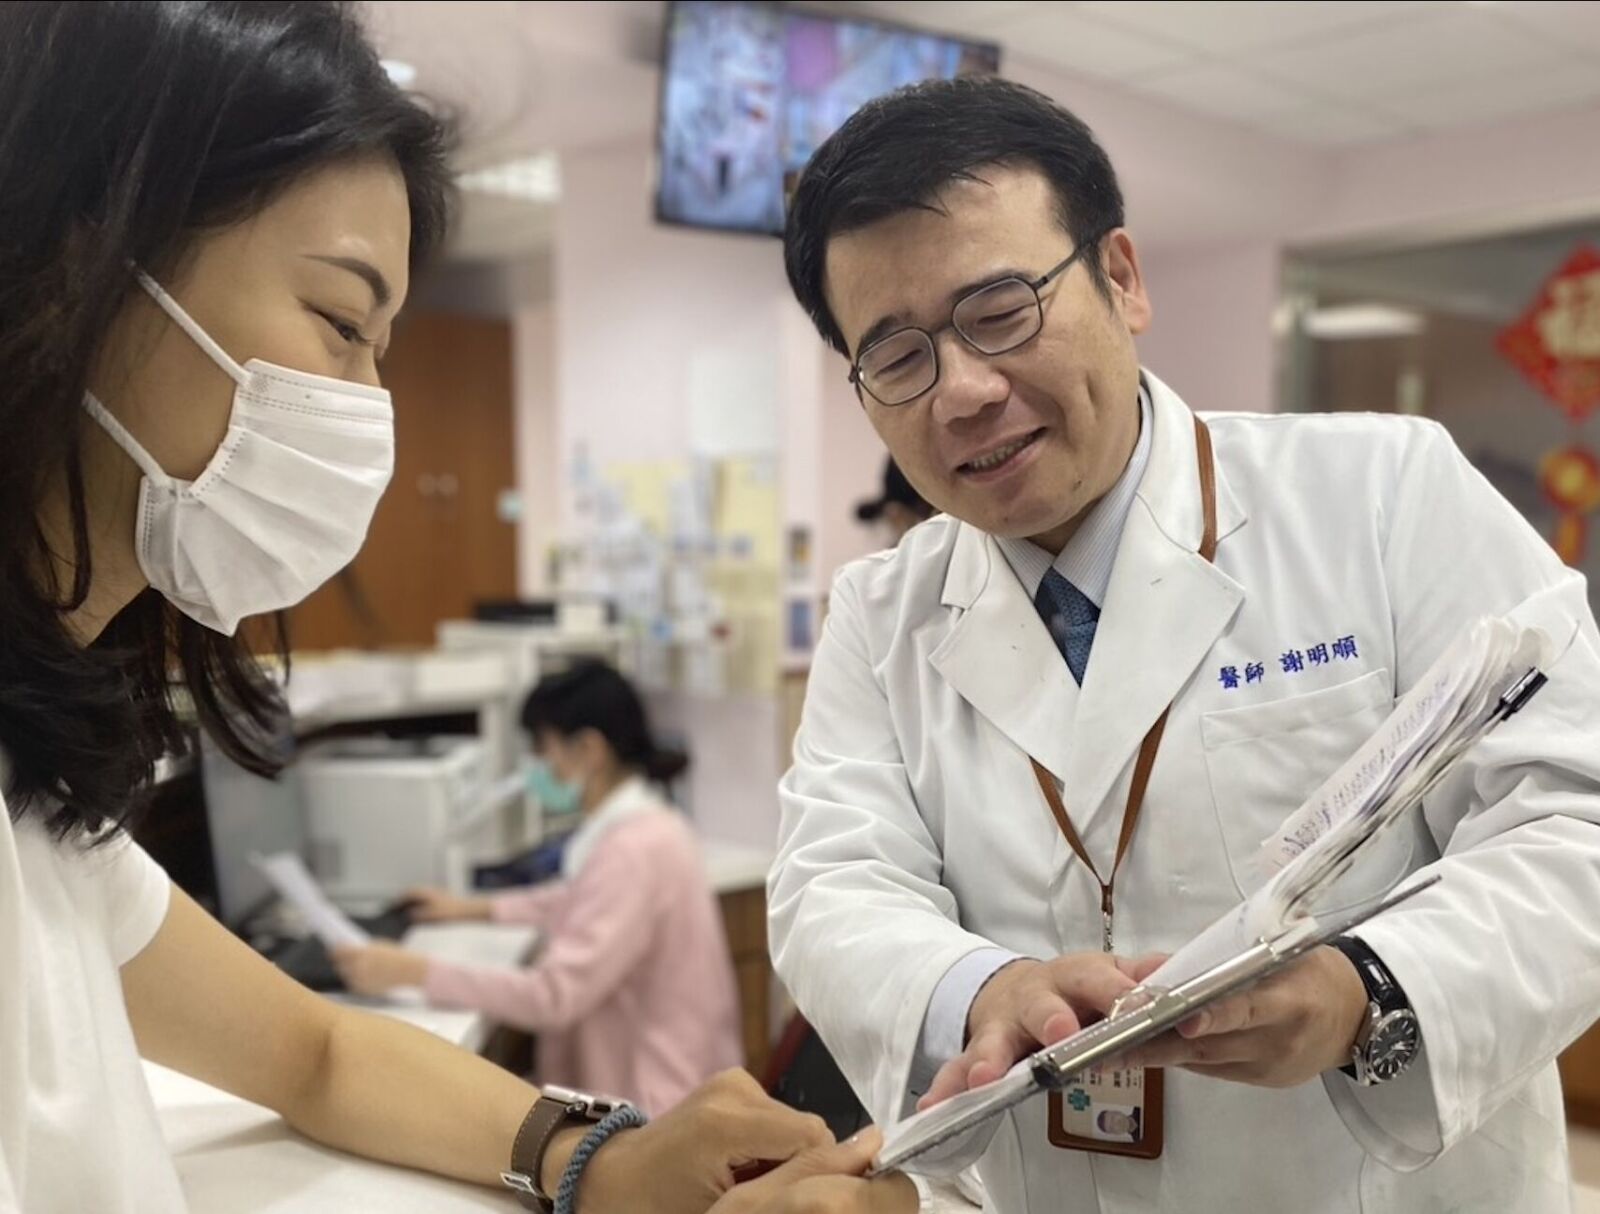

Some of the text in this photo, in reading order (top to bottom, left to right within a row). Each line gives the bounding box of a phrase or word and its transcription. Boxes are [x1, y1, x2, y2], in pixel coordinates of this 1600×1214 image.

[1218, 635, 1359, 689] 醫師 謝明順
